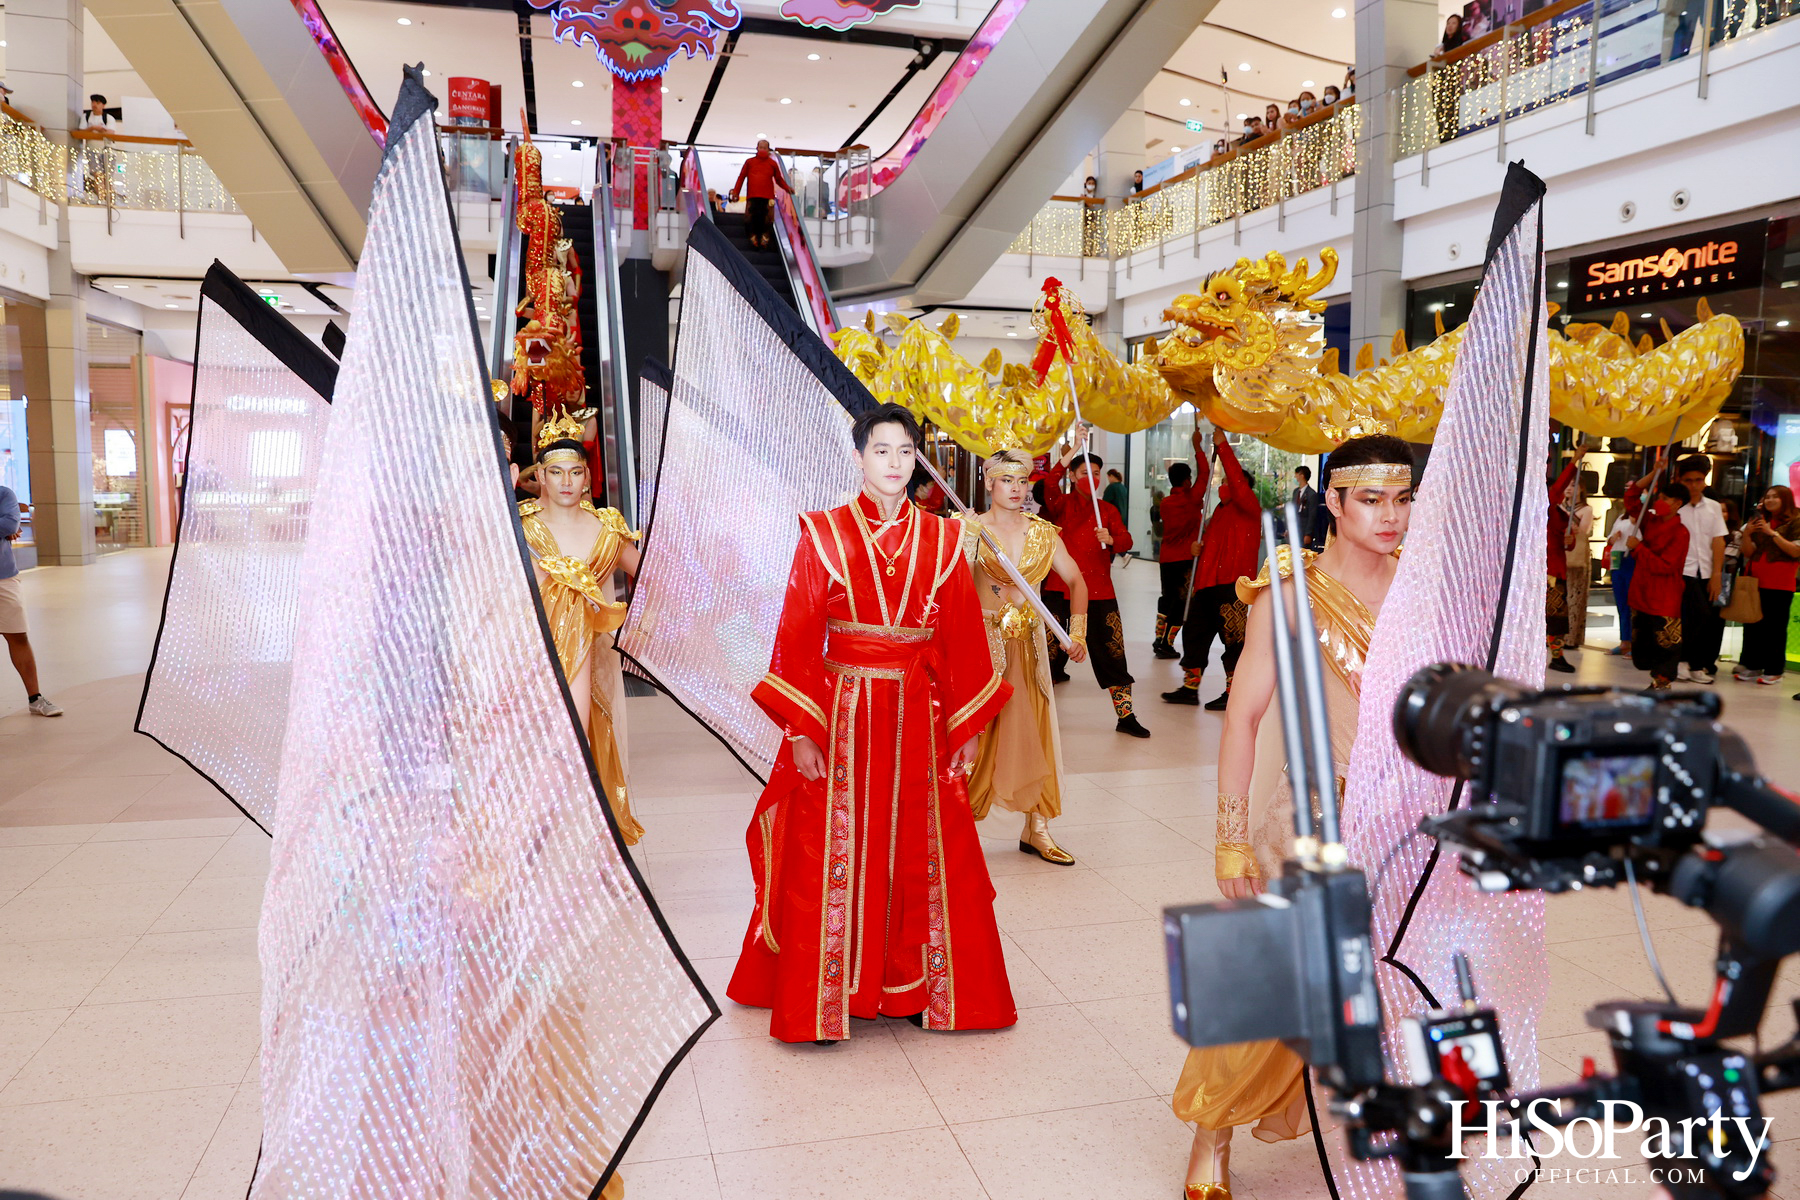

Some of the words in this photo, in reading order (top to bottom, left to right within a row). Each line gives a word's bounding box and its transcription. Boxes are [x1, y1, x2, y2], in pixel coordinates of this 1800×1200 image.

[451, 89, 486, 100] CENTARA
[1587, 241, 1738, 287] Samsonite
[1586, 285, 1649, 302] BLACK
[1661, 271, 1735, 290] LABEL
